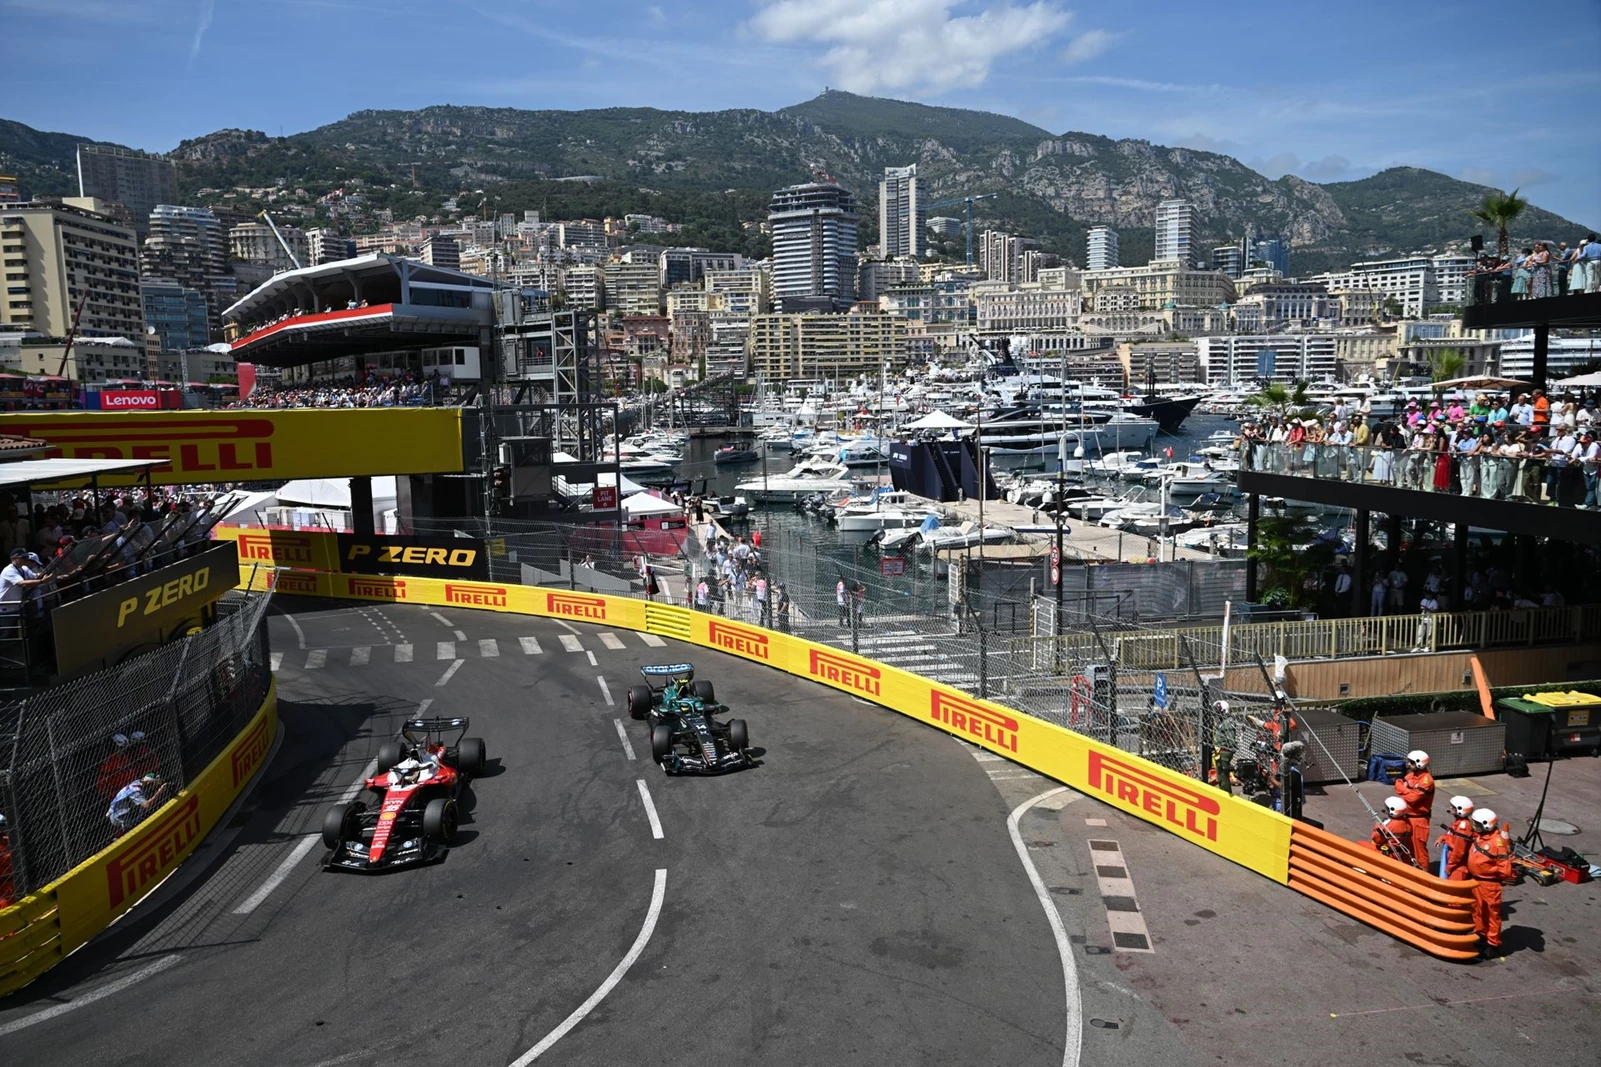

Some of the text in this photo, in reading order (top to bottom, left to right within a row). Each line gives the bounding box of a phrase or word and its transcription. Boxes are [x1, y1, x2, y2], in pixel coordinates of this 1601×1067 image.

[106, 395, 156, 406] Lenovo
[238, 534, 312, 562] PIRELLI
[348, 544, 477, 567] P ZERO
[267, 572, 317, 592] PIRELLI
[348, 578, 406, 598] PIRELLI
[445, 584, 506, 607] PIRELLI
[117, 566, 210, 628] P ZERO
[546, 593, 606, 620] PIRELLI
[709, 621, 768, 659] PIRELLI
[645, 664, 689, 673] aramco
[809, 649, 881, 697] PIRELLI
[930, 689, 1019, 754] PIRELLI
[231, 715, 269, 790] PIRELLI
[1088, 750, 1220, 843] PIRELLI
[106, 794, 200, 910] PIRELLI
